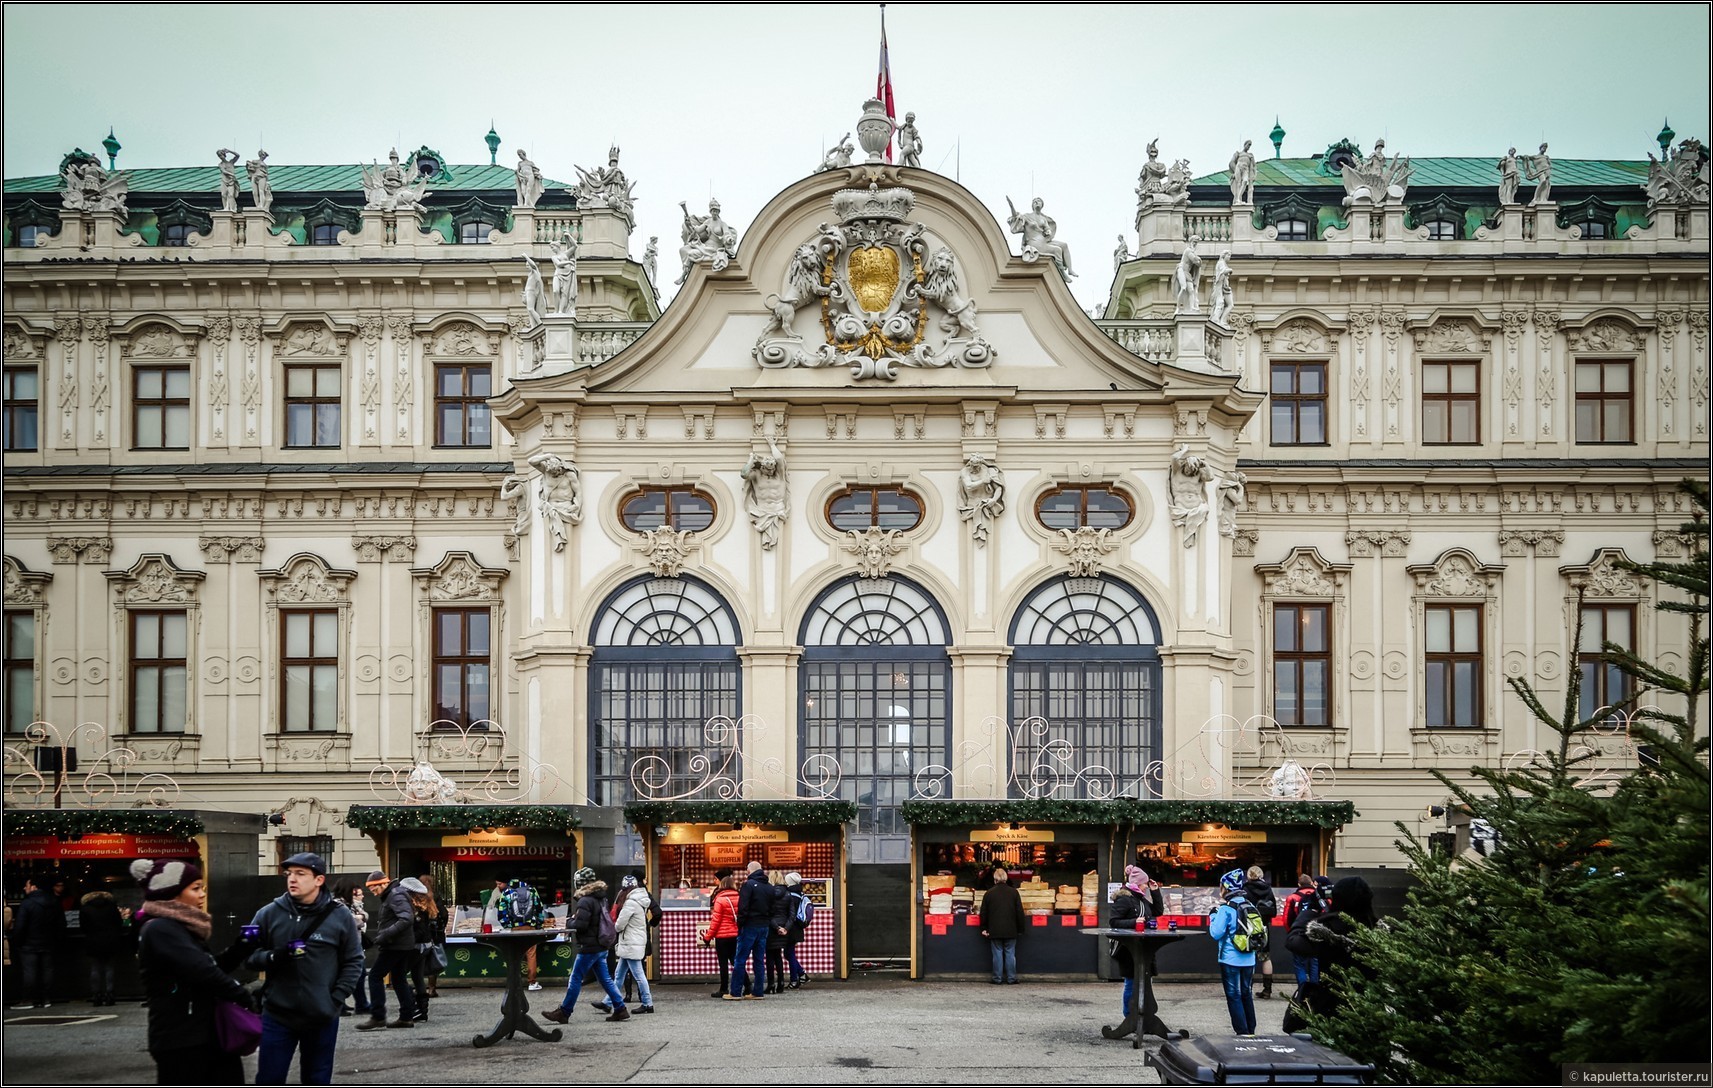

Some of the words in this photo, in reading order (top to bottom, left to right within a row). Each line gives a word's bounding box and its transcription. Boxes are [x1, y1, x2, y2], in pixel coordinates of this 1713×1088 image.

[742, 833, 777, 841] Spiralkartoffel
[60, 848, 124, 856] Orangenpunsch
[137, 847, 190, 855] Kokospunsch
